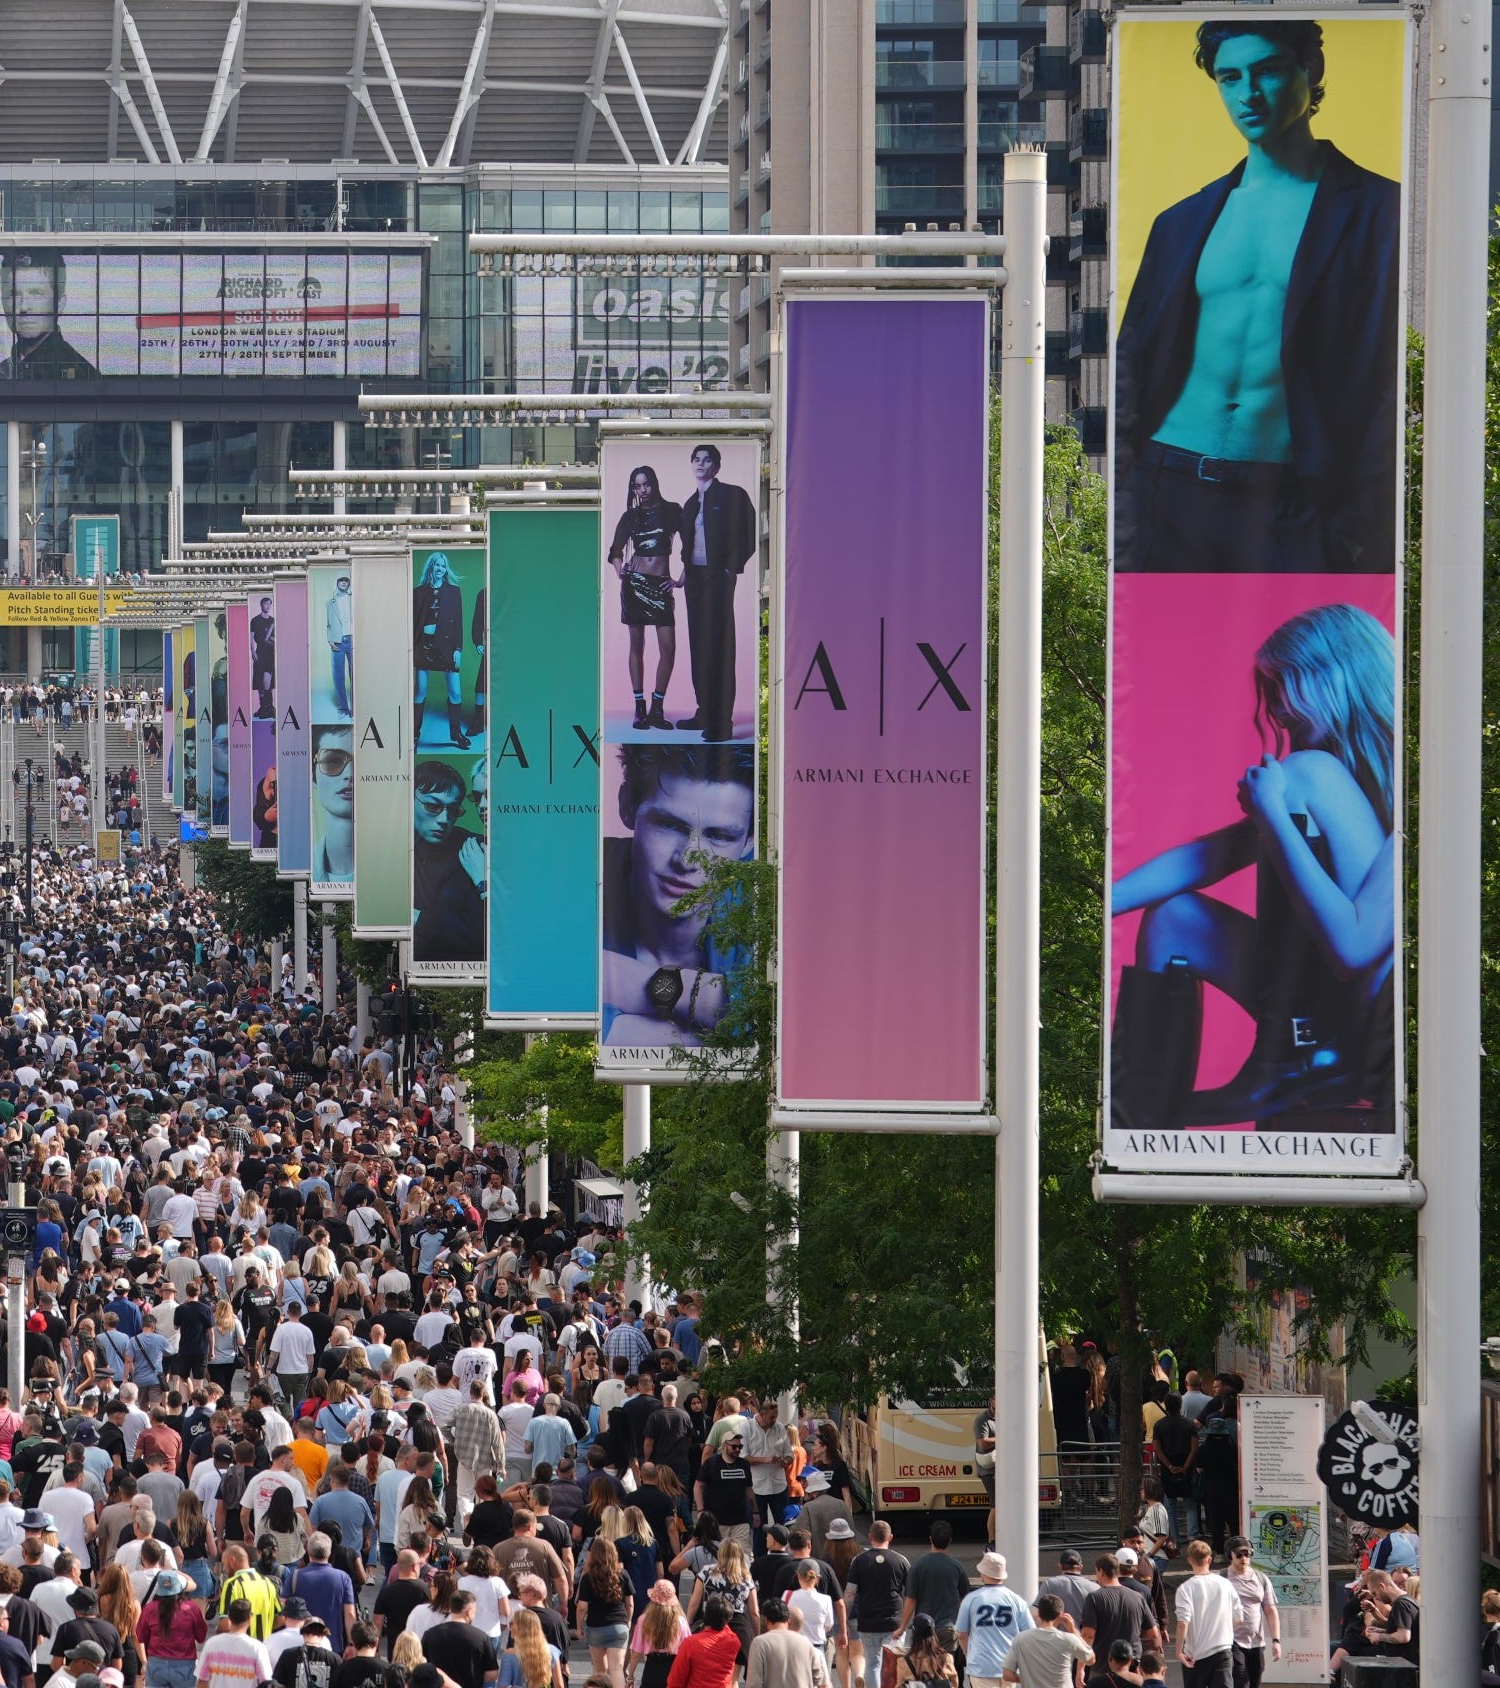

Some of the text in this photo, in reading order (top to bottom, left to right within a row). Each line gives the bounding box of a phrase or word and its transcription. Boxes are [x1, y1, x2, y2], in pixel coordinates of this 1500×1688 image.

[223, 278, 283, 288] RICHARD
[215, 287, 288, 298] ASHCROFT
[296, 290, 322, 299] CAST
[234, 309, 302, 324] SOLD OUT
[191, 328, 345, 336] LONDON WEMBLEY STADIUM
[141, 339, 167, 347] 25TH
[182, 339, 209, 347] 26TH
[222, 339, 249, 347] 30TH
[252, 339, 281, 347] JULY
[291, 339, 315, 347] 2ND
[327, 339, 350, 347] 3RD
[353, 339, 397, 347] AUGUST
[199, 351, 228, 359] 27TH
[239, 351, 268, 359] 28TH
[272, 351, 337, 359] SEPTEMBER
[571, 356, 669, 394] live
[8, 592, 51, 601] Available
[53, 592, 64, 601] to
[65, 592, 77, 601] all
[8, 605, 108, 616] Pitch Standing tickes
[232, 706, 248, 727] A
[281, 705, 301, 730] A
[360, 774, 393, 782] ARMANI
[793, 769, 972, 784] ARMANI EXCHANGE
[496, 804, 540, 814] ARMANI
[316, 882, 345, 890] ARMANI
[419, 962, 456, 970] ARMANI
[610, 1047, 664, 1060] ARMANI
[1125, 1134, 1382, 1158] ARMANI EXCHANGE
[118, 1221, 134, 1233] 25
[308, 1280, 328, 1293] 25
[36, 1454, 65, 1472] 25
[899, 1465, 957, 1476] ICE CREAM
[975, 1605, 1013, 1627] 25
